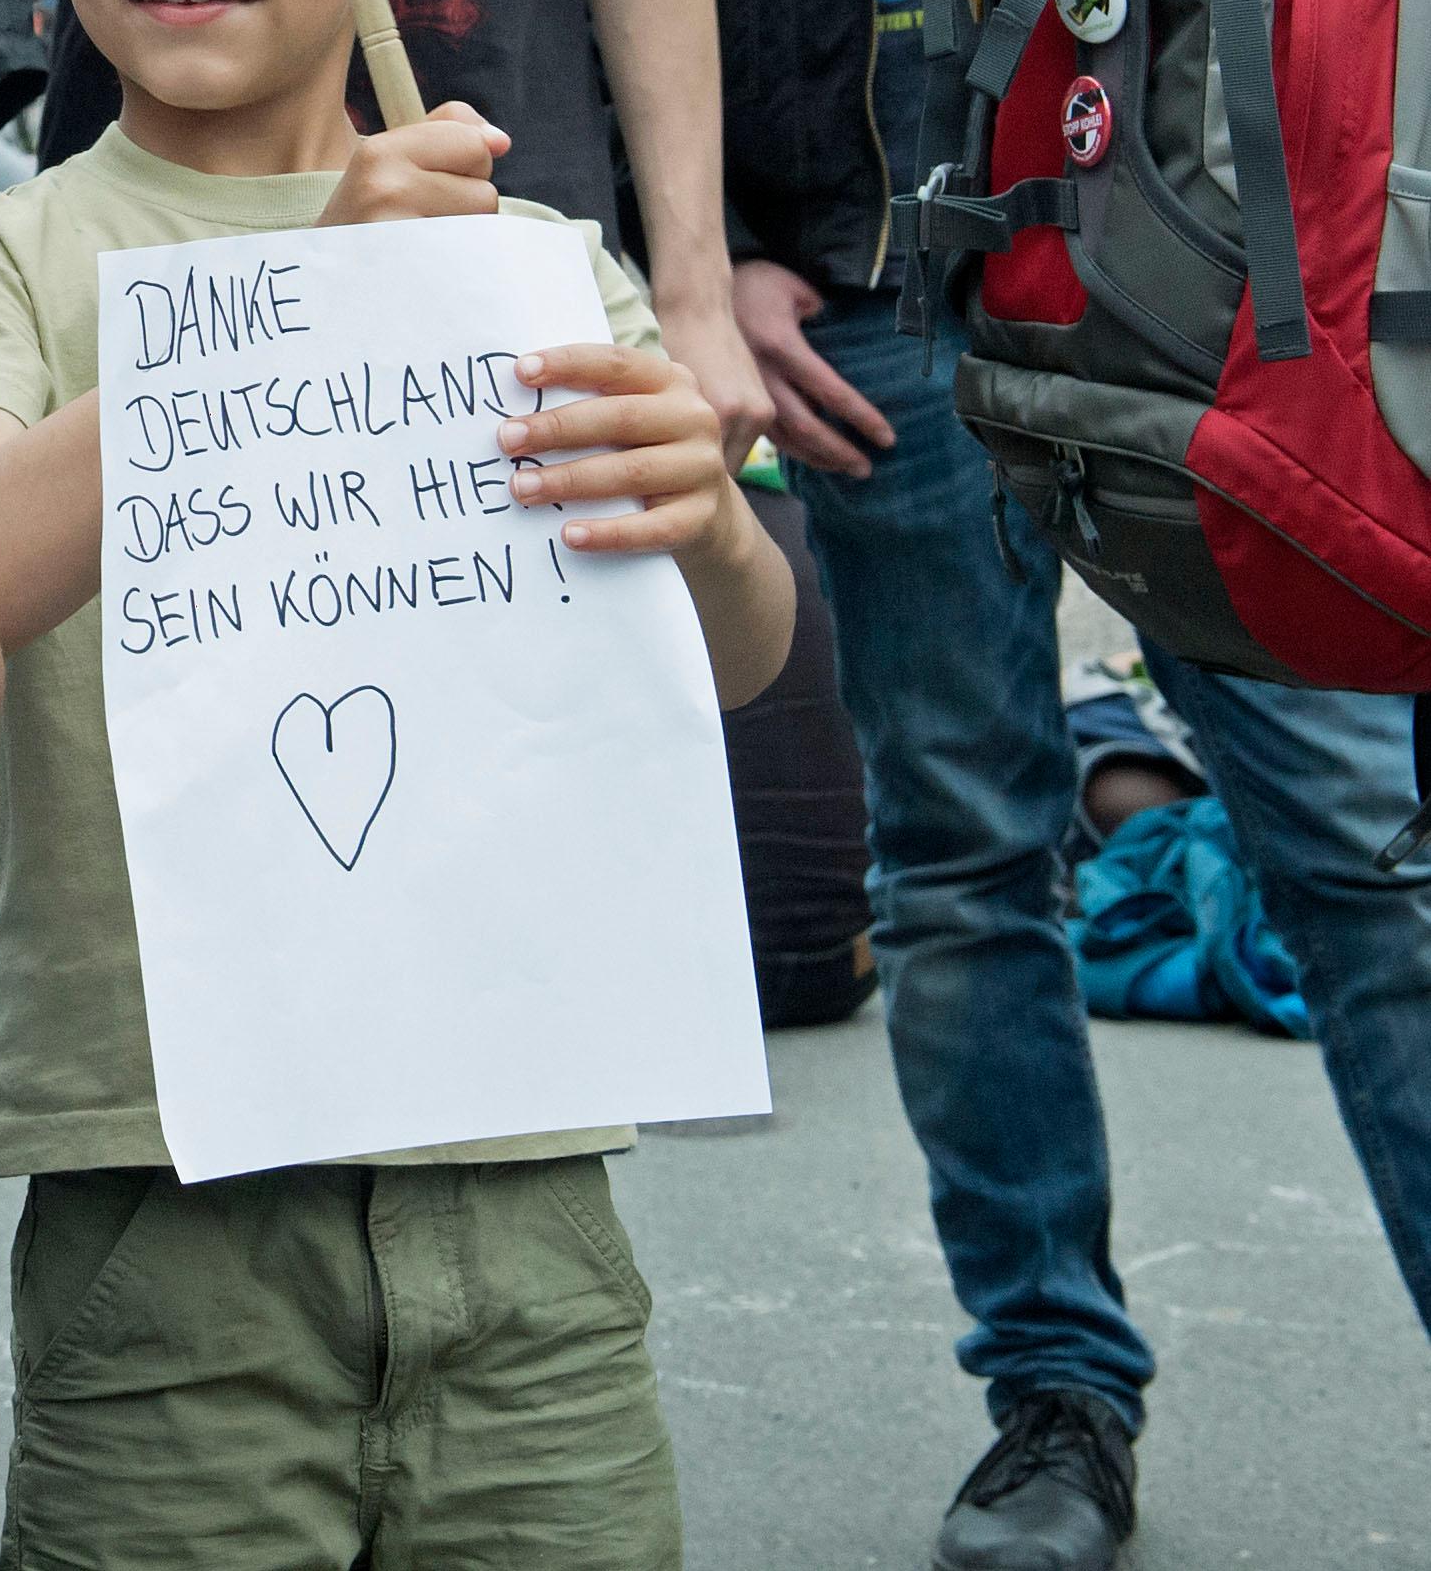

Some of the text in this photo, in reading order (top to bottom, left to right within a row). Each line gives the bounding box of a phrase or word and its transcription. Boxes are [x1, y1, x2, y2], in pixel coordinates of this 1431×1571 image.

[125, 259, 311, 371] DANKE
[117, 484, 252, 563] DASS
[275, 470, 381, 531] WIR
[120, 583, 242, 654] SEIN
